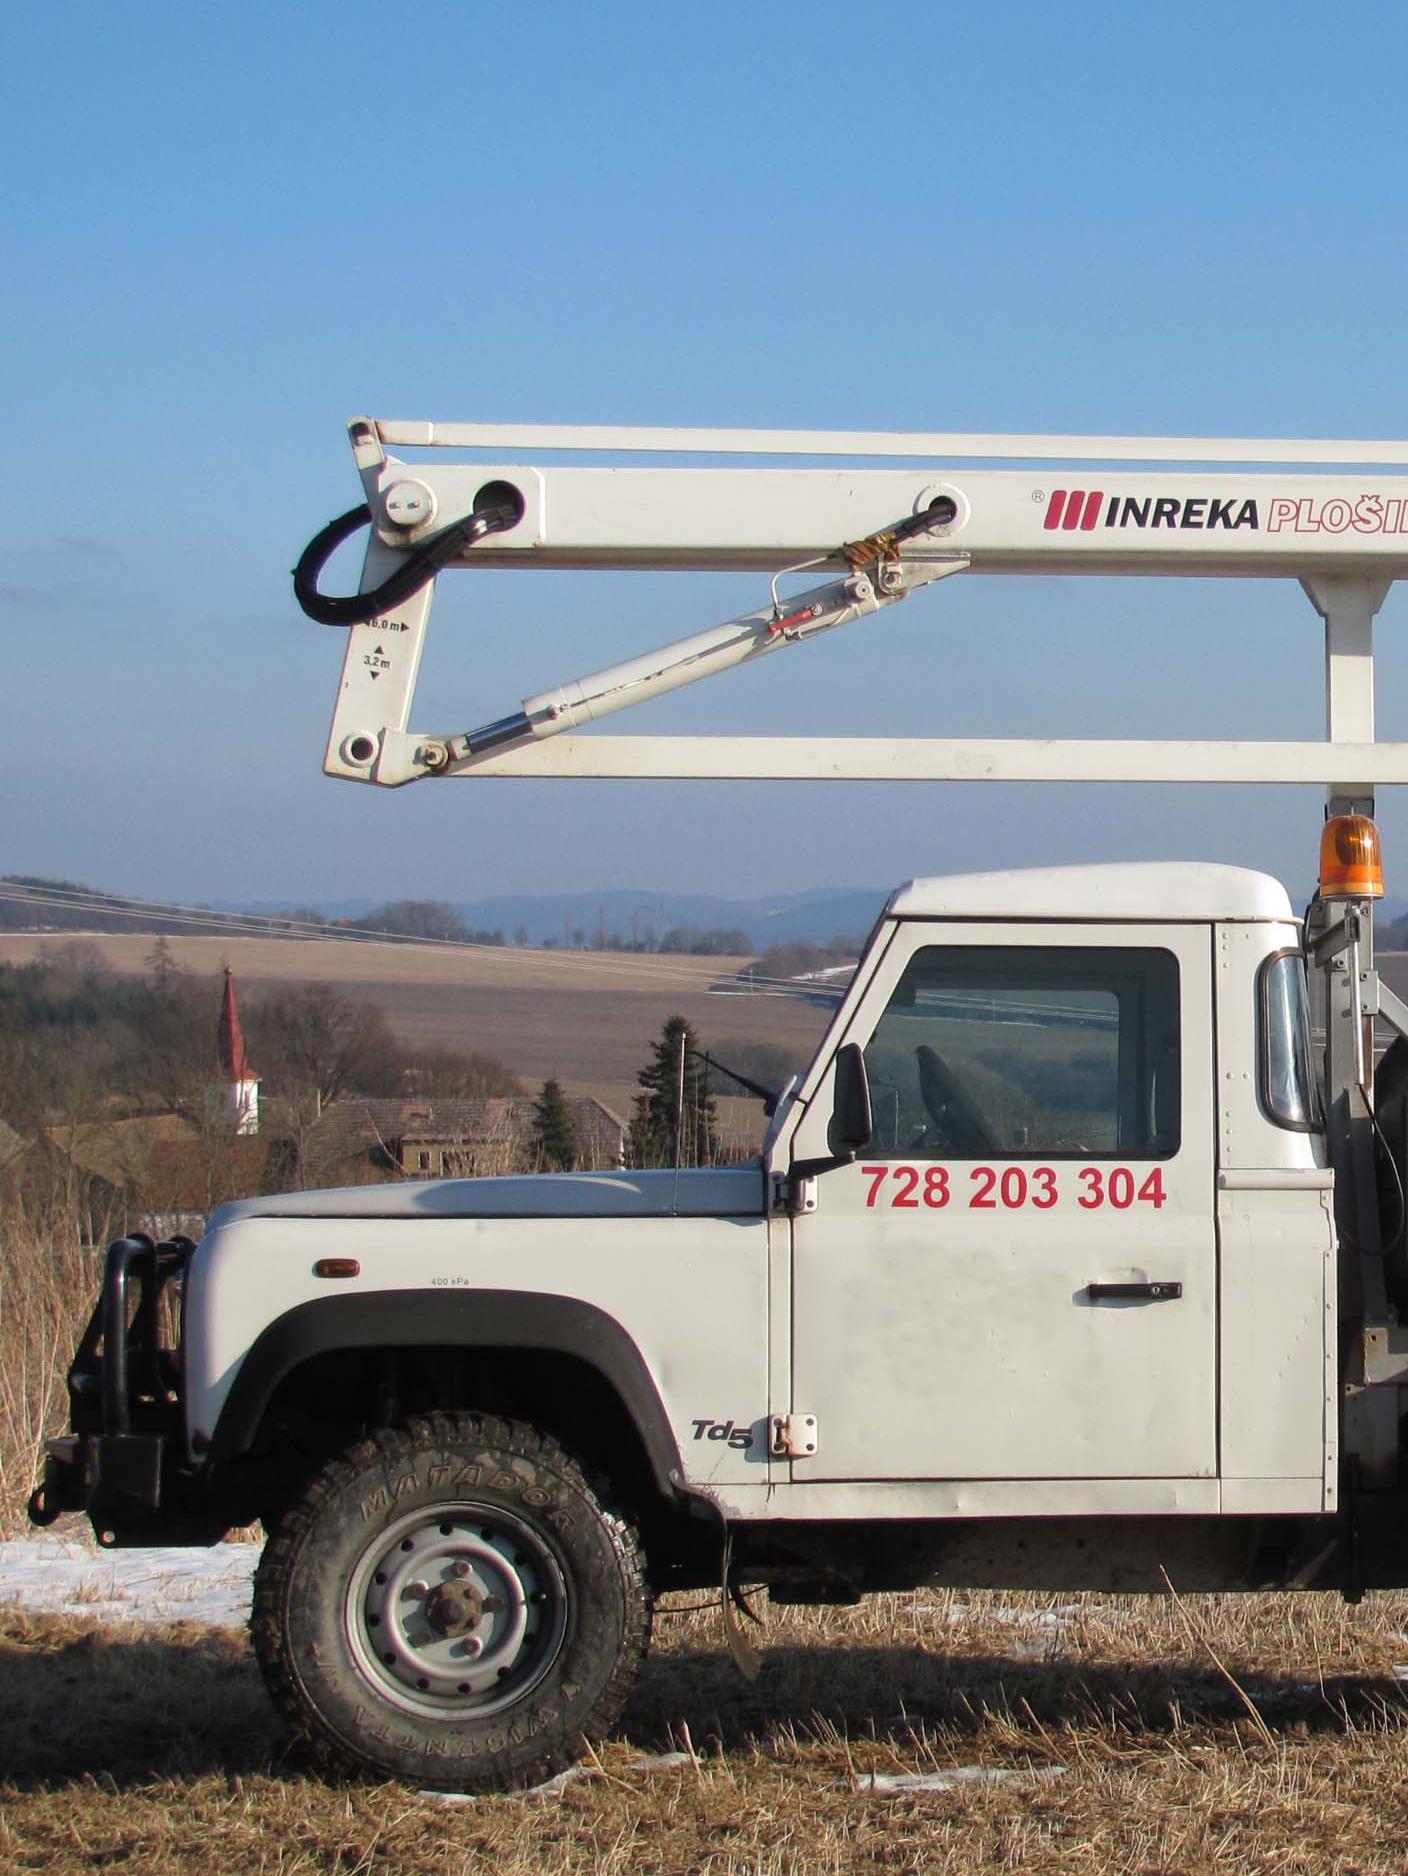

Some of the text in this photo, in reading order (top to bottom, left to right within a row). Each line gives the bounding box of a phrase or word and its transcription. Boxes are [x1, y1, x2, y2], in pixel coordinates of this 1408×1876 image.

[1105, 497, 1259, 530] INREKA
[862, 1164, 1168, 1210] 728 203 304
[691, 1420, 755, 1453] Td5
[361, 1466, 576, 1530] MATADOR
